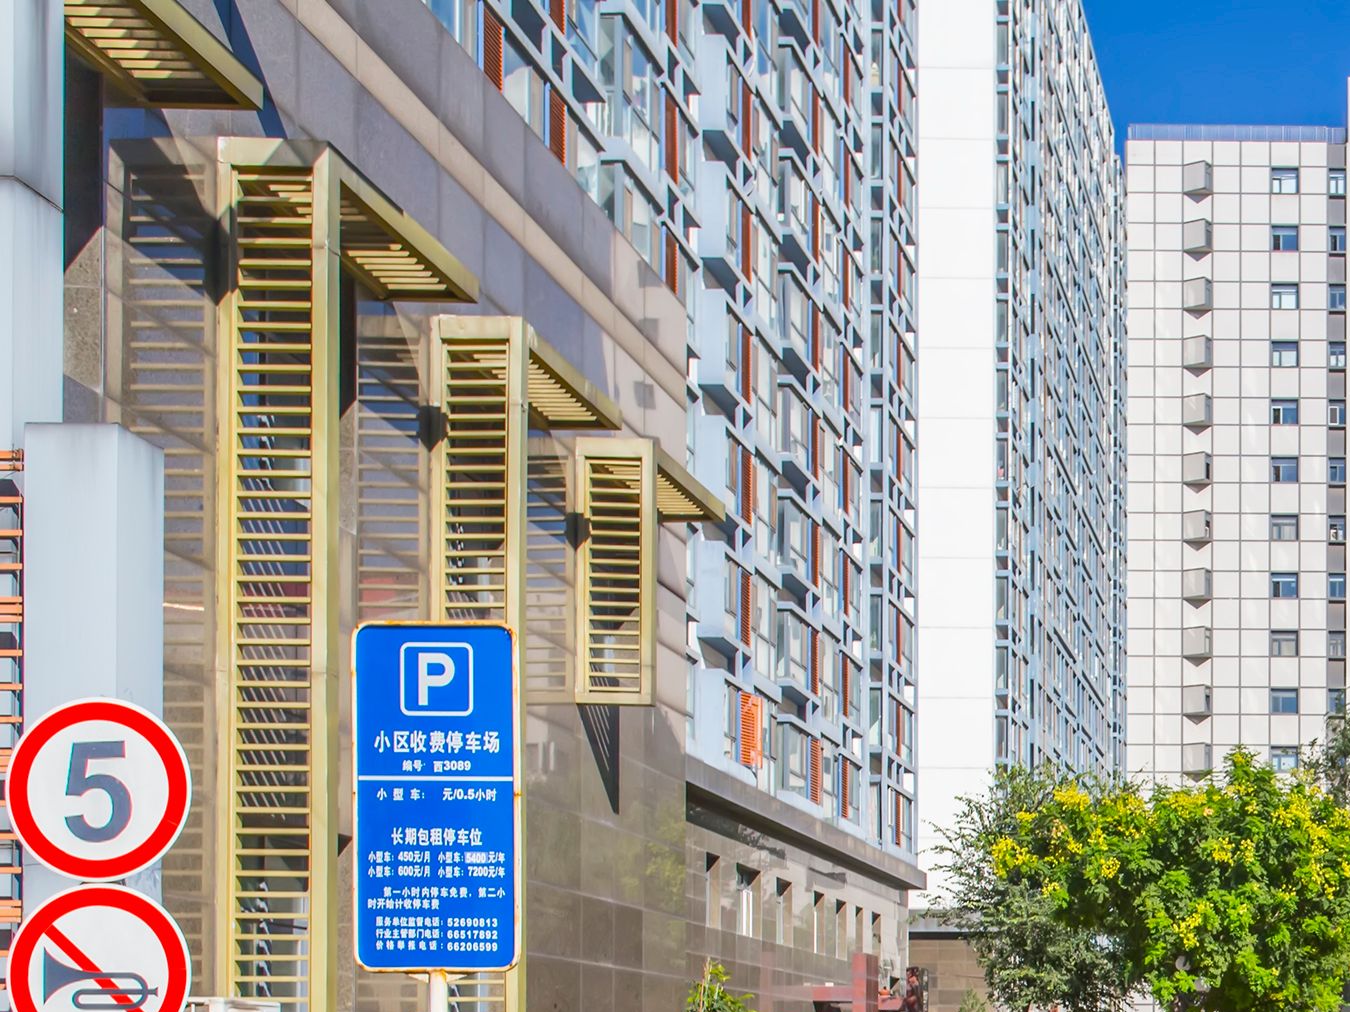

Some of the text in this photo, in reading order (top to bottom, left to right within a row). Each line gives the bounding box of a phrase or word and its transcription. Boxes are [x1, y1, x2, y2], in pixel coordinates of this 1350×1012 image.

[418, 652, 456, 706] P
[374, 730, 500, 753] 小区收费停车场
[64, 740, 132, 843] 5
[391, 827, 483, 846] 长期包租停车位
[367, 898, 440, 910] 时开始计收停车费
